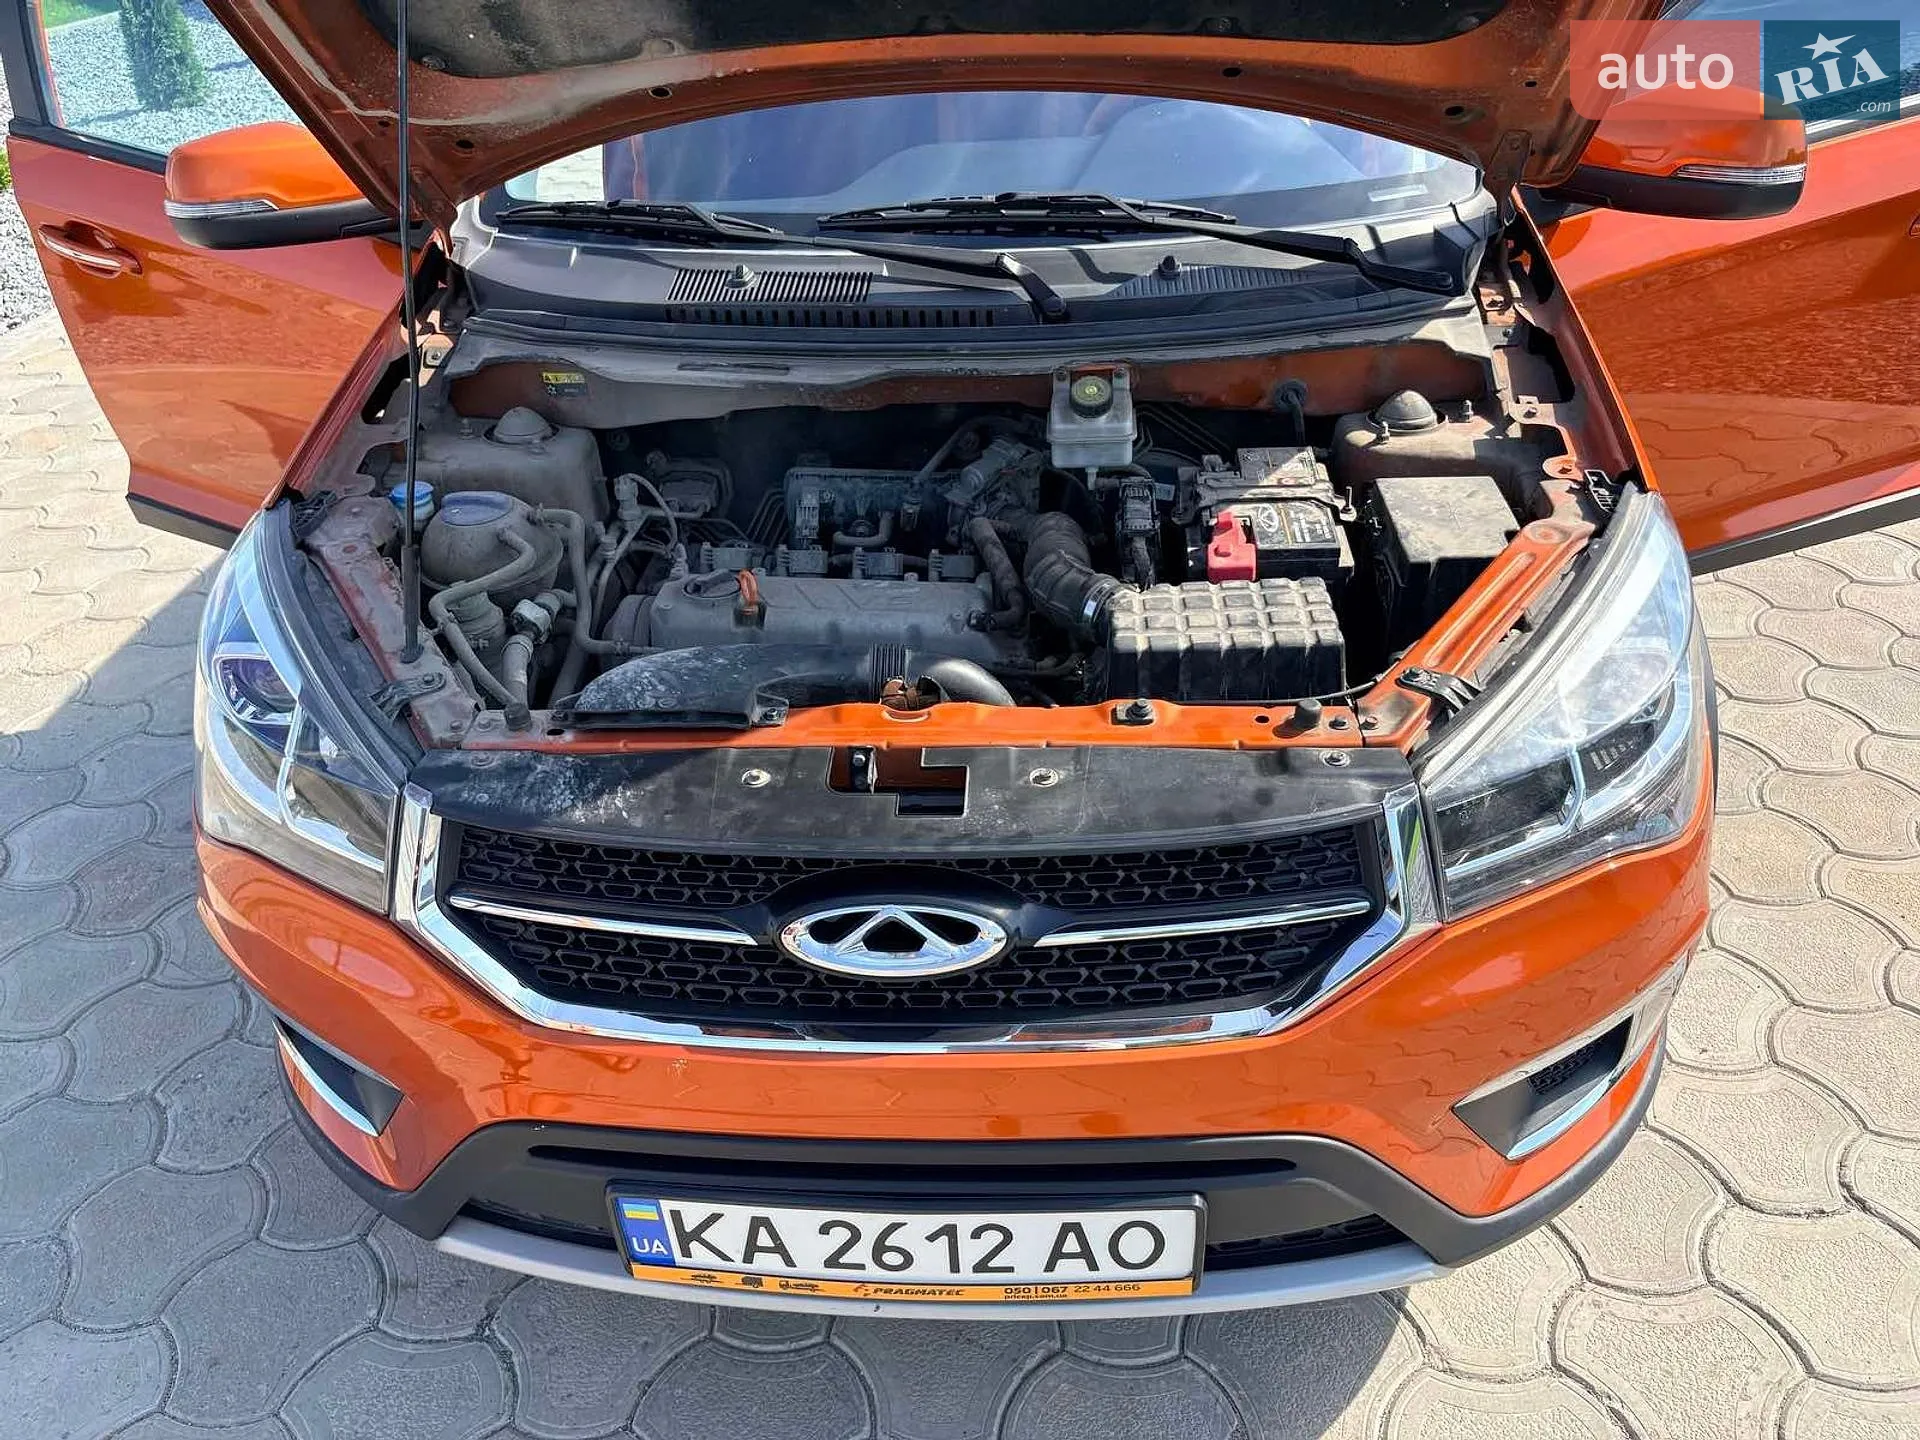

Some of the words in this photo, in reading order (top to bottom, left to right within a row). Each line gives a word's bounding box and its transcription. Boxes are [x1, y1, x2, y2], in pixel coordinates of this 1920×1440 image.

[632, 1237, 669, 1255] UA
[669, 1209, 798, 1269] KA
[818, 1219, 1015, 1274] 2612
[1043, 1220, 1166, 1273] AO
[872, 1286, 966, 1297] PRAGMATEC
[1004, 1287, 1031, 1295] 050
[1041, 1286, 1069, 1295] 067
[1074, 1285, 1091, 1293] 22
[1093, 1284, 1111, 1292] 44
[1114, 1283, 1142, 1292] 666
